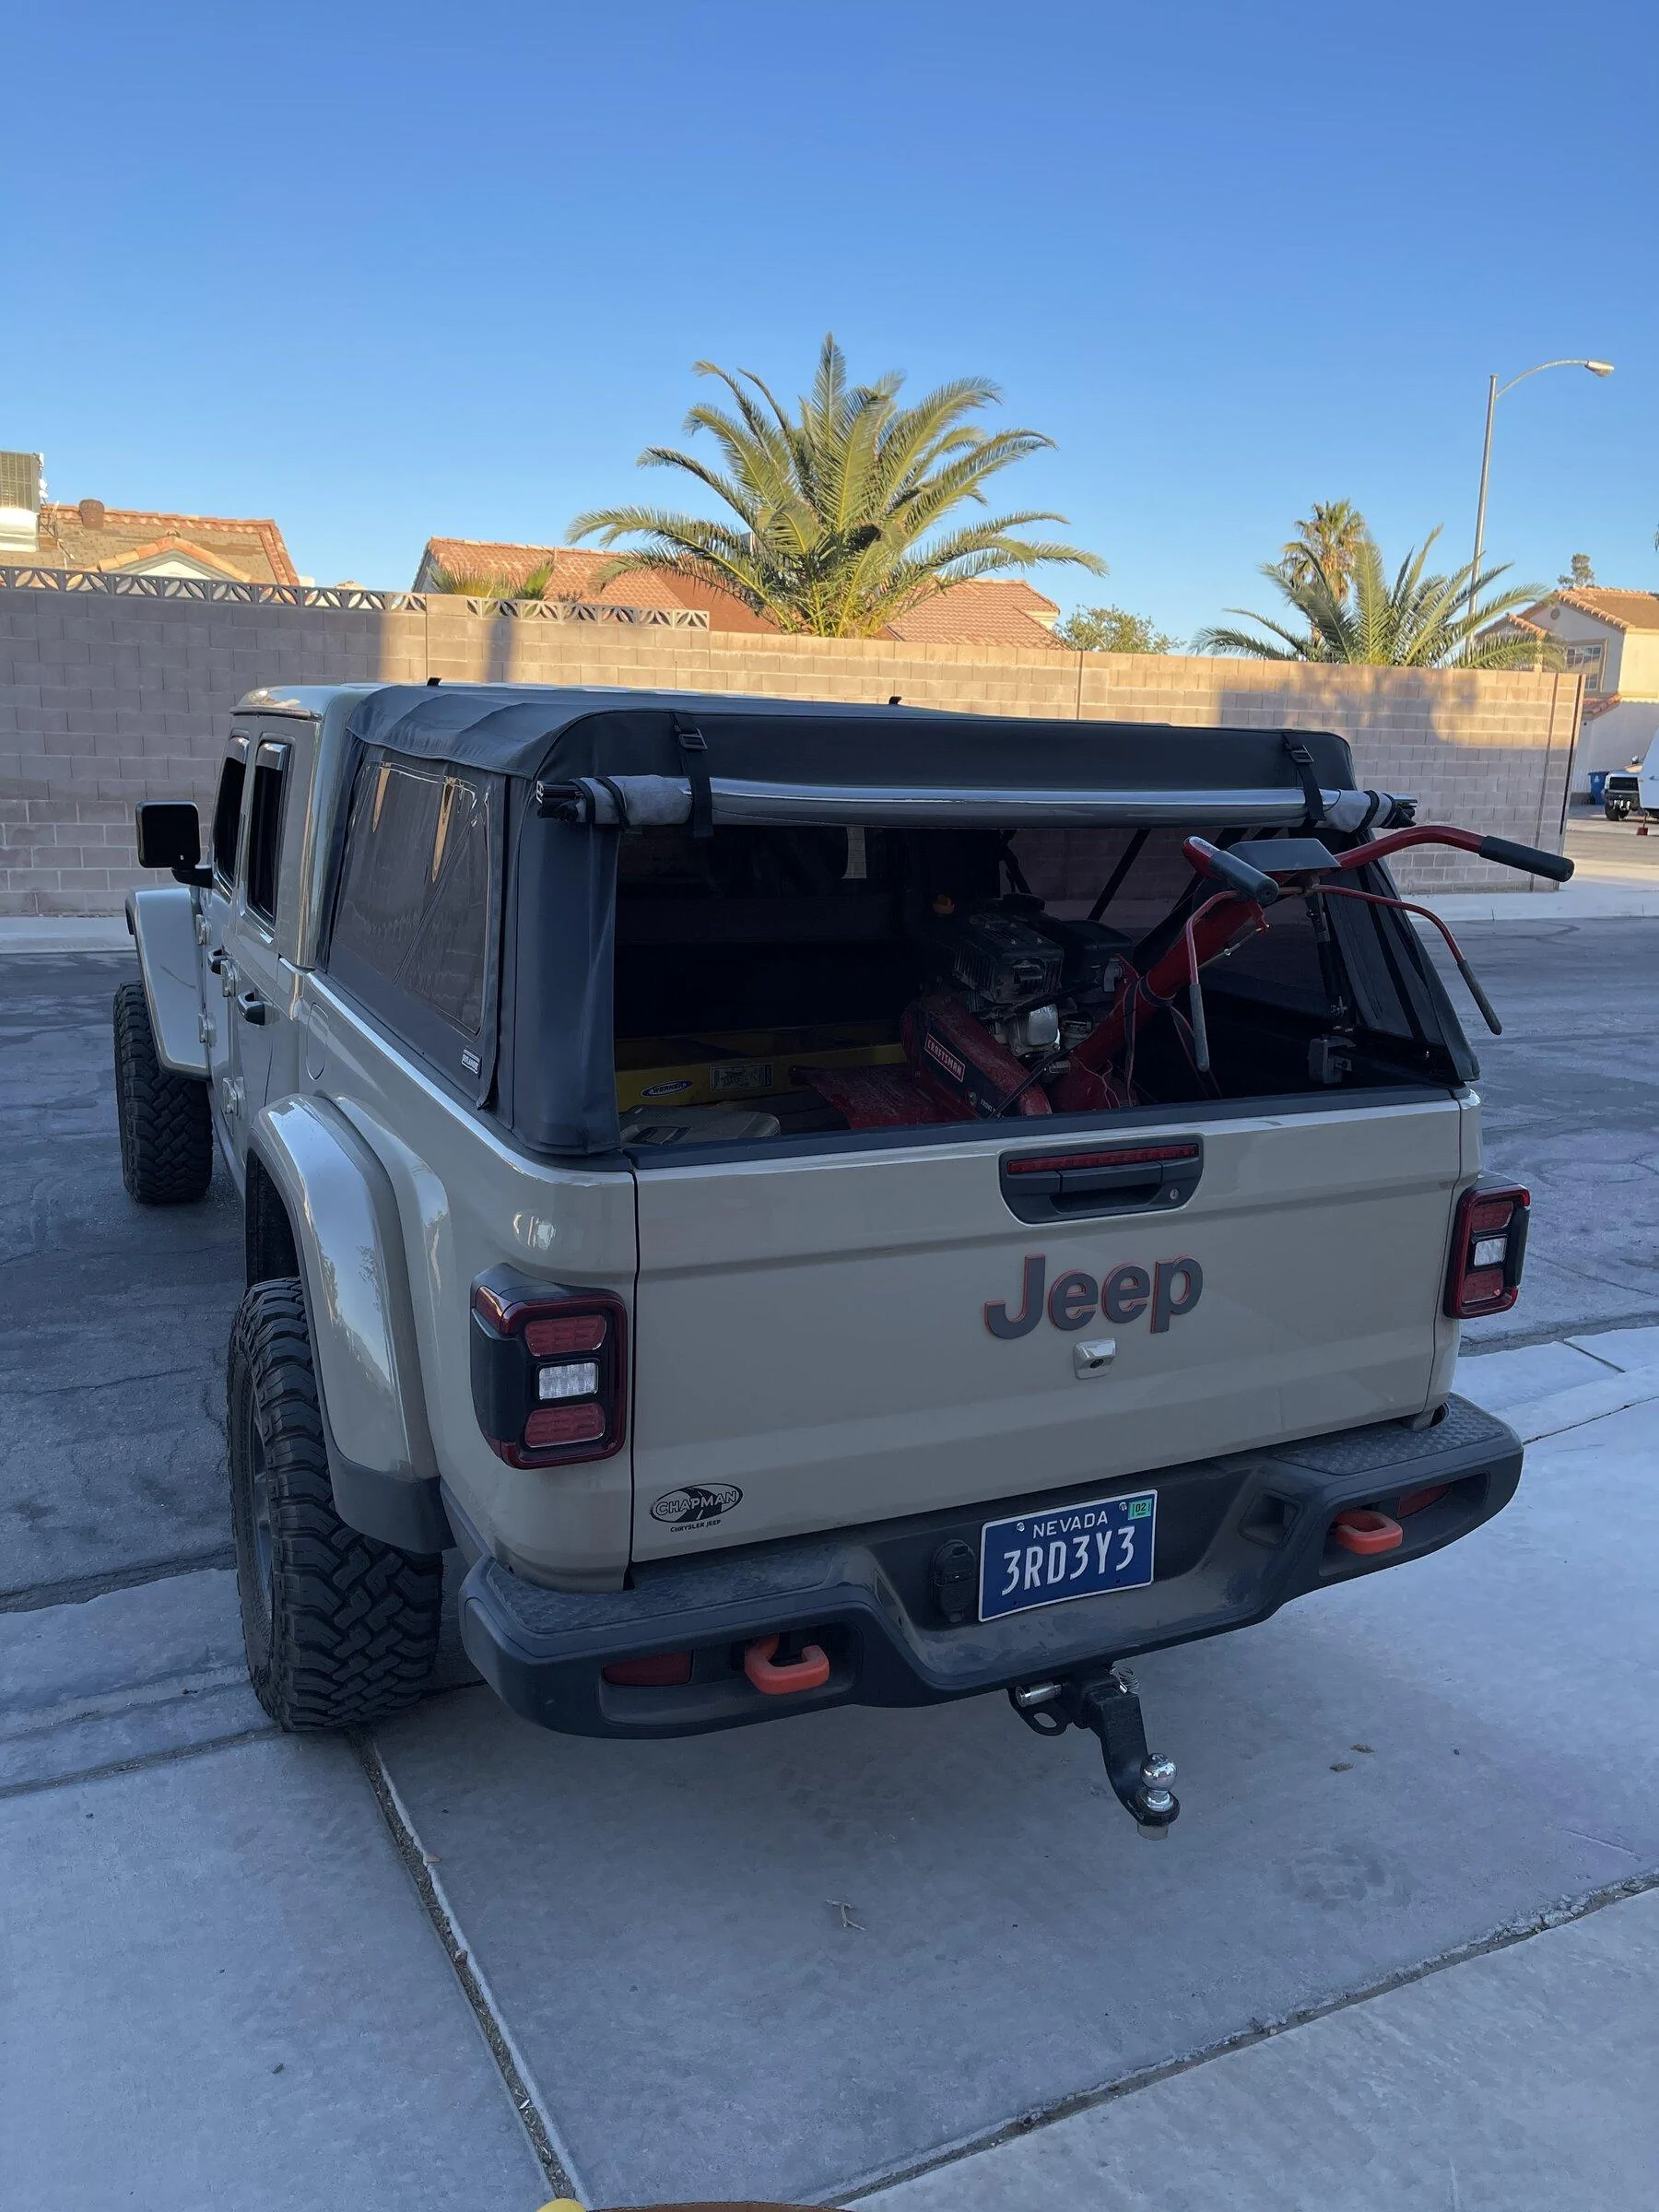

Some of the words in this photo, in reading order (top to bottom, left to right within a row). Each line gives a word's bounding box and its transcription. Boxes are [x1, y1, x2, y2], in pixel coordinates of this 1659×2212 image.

[927, 1039, 962, 1077] CRAFTSMAN
[652, 1083, 684, 1093] WERNER
[983, 1253, 1204, 1339] Jeep
[655, 1490, 737, 1515] CHAPMAN
[1135, 1502, 1147, 1512] 02
[670, 1522, 705, 1532] CHRYSLER
[705, 1519, 722, 1527] JEEP
[1032, 1511, 1108, 1539] NEVADA
[1001, 1525, 1135, 1597] 3RD3Y3
